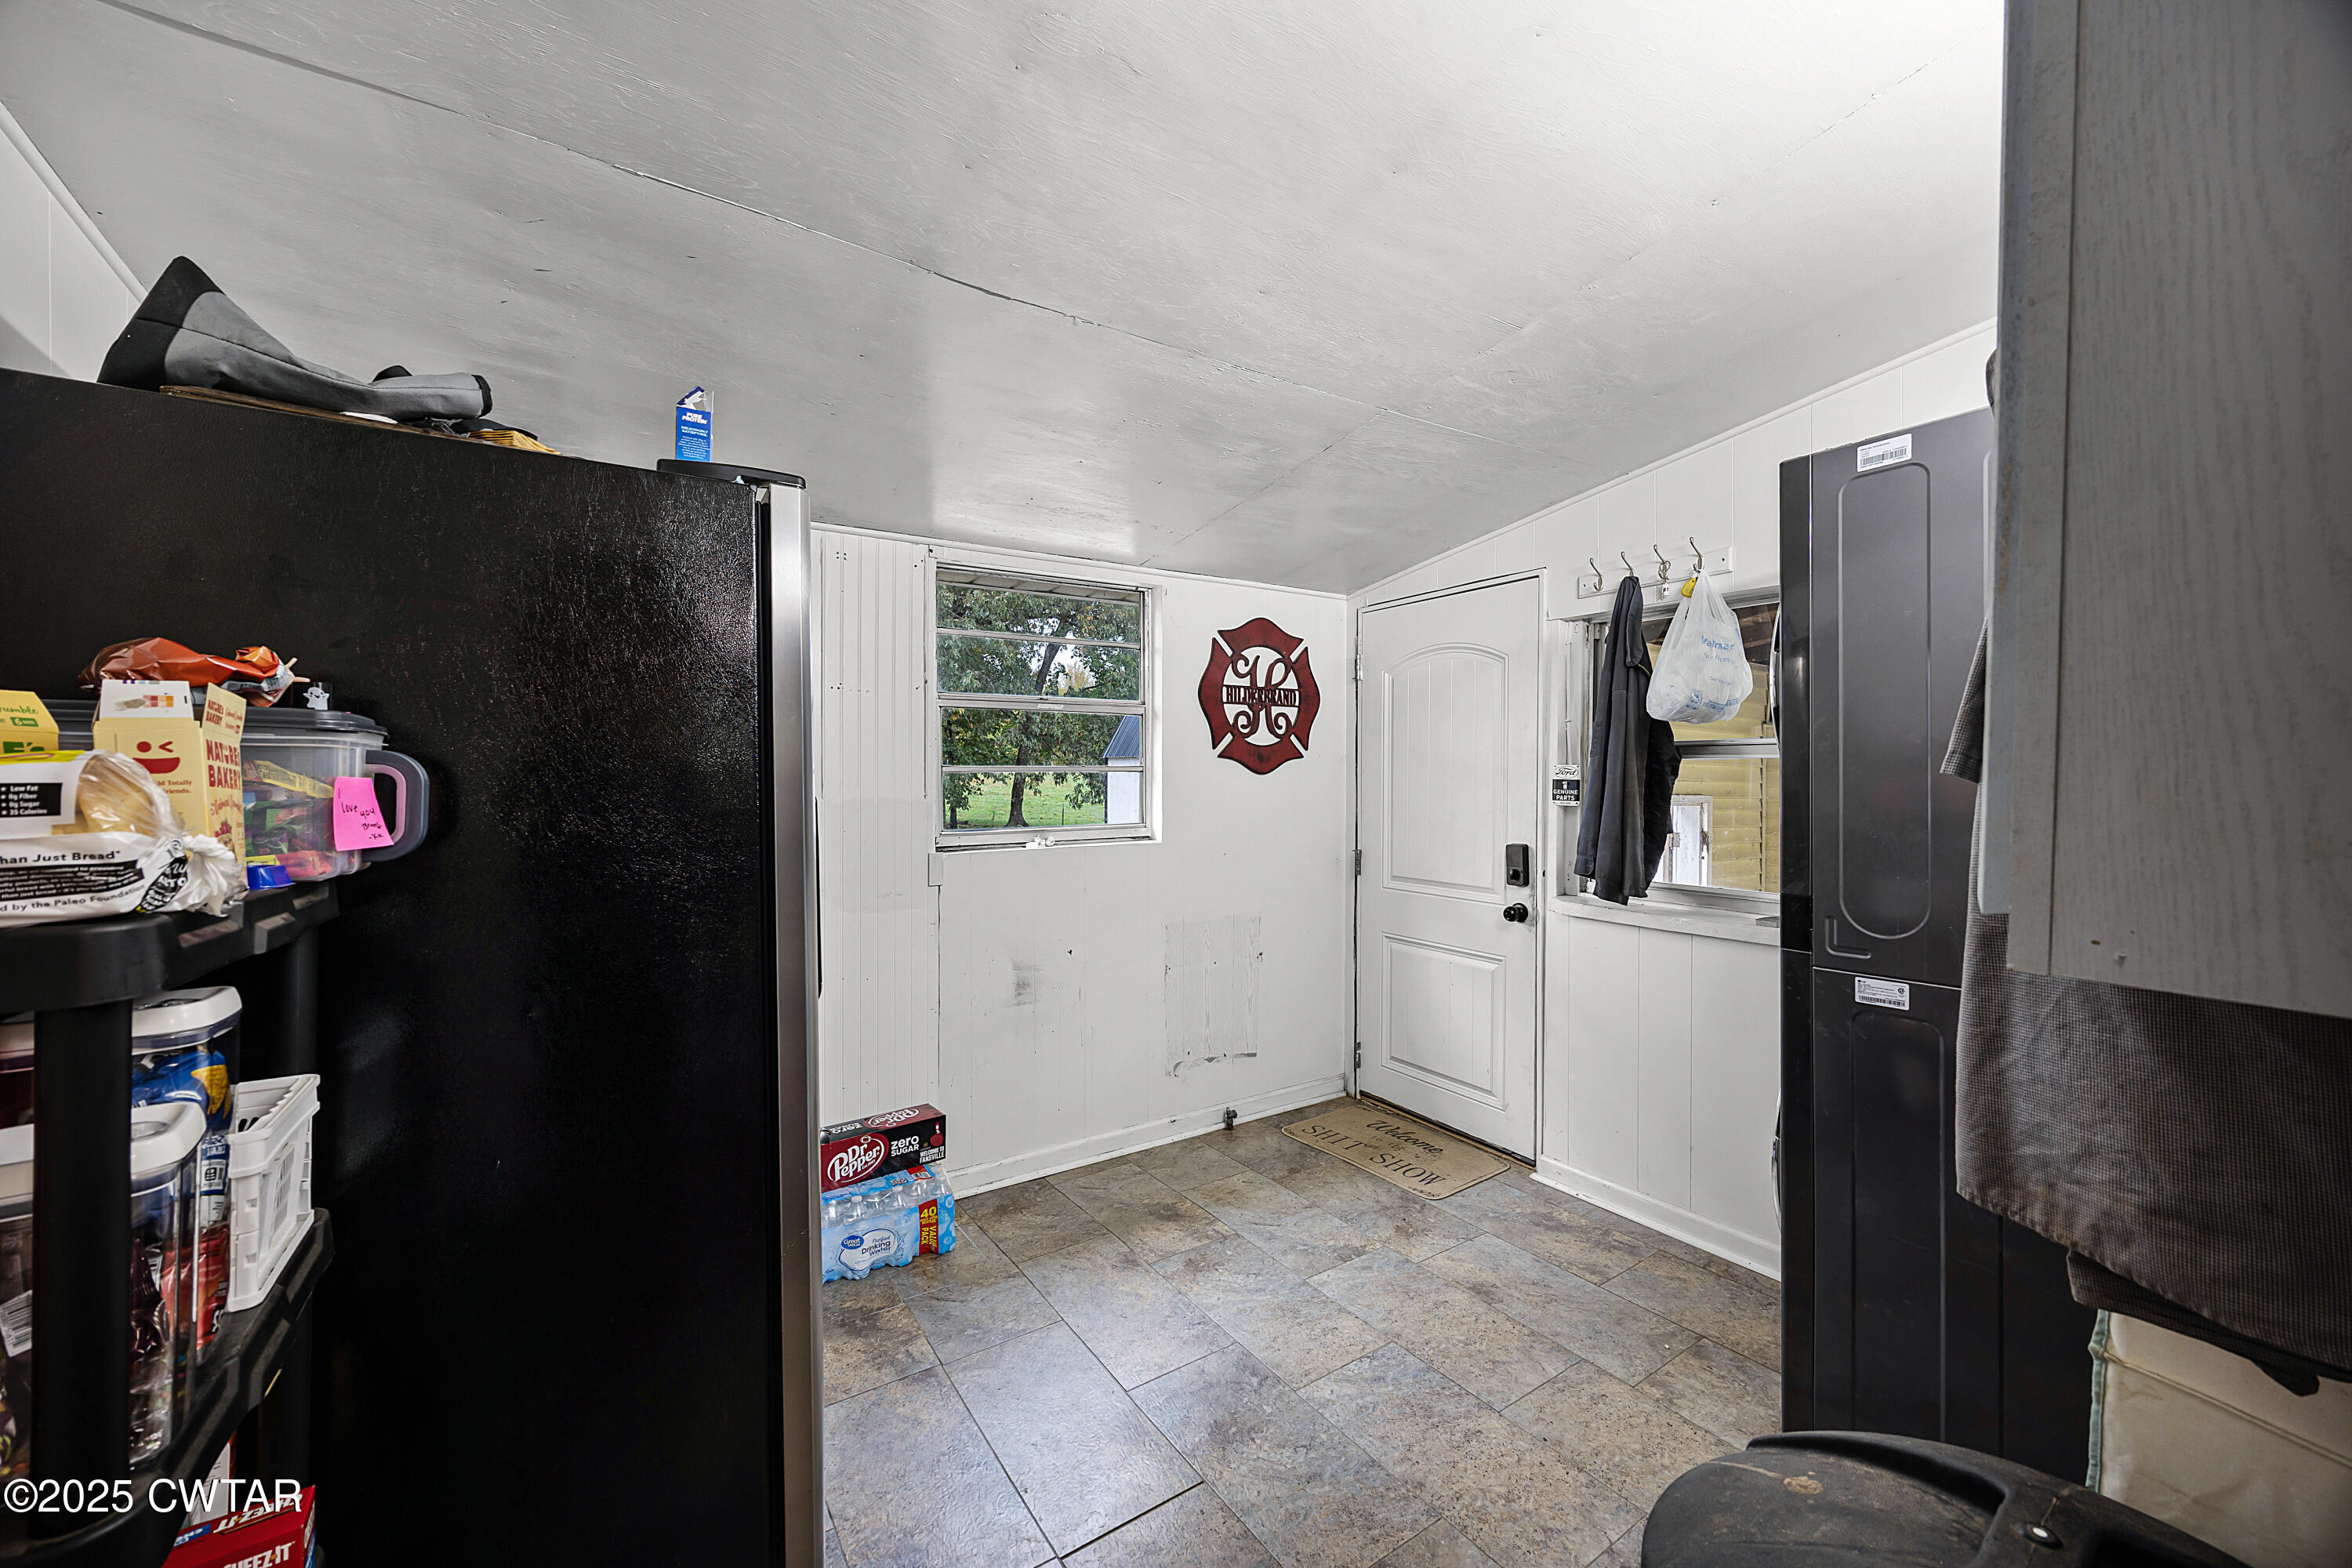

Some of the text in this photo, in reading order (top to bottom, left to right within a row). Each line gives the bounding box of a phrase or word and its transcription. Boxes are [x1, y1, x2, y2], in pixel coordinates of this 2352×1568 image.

[682, 416, 707, 424] PROTEIN
[208, 764, 241, 791] BAKERY
[360, 808, 376, 819] you
[0, 851, 27, 864] han
[33, 854, 66, 863] Just
[13, 903, 27, 913] by
[54, 898, 86, 908] Paleo
[90, 884, 145, 902] Foundation
[891, 1136, 919, 1150] zero
[1301, 1125, 1368, 1150] SHIT
[1367, 1120, 1443, 1154] Welcome
[891, 1144, 919, 1156] SUGAR
[920, 1148, 939, 1156] WELCOME
[1388, 1142, 1406, 1151] the
[848, 1144, 867, 1163] Dr
[920, 1152, 944, 1163] FANSVILLE
[830, 1146, 880, 1182] Pepper
[1370, 1153, 1446, 1185] SHOW
[920, 1207, 937, 1218] 40
[862, 1240, 891, 1254] Drinking
[869, 1247, 891, 1256] Water
